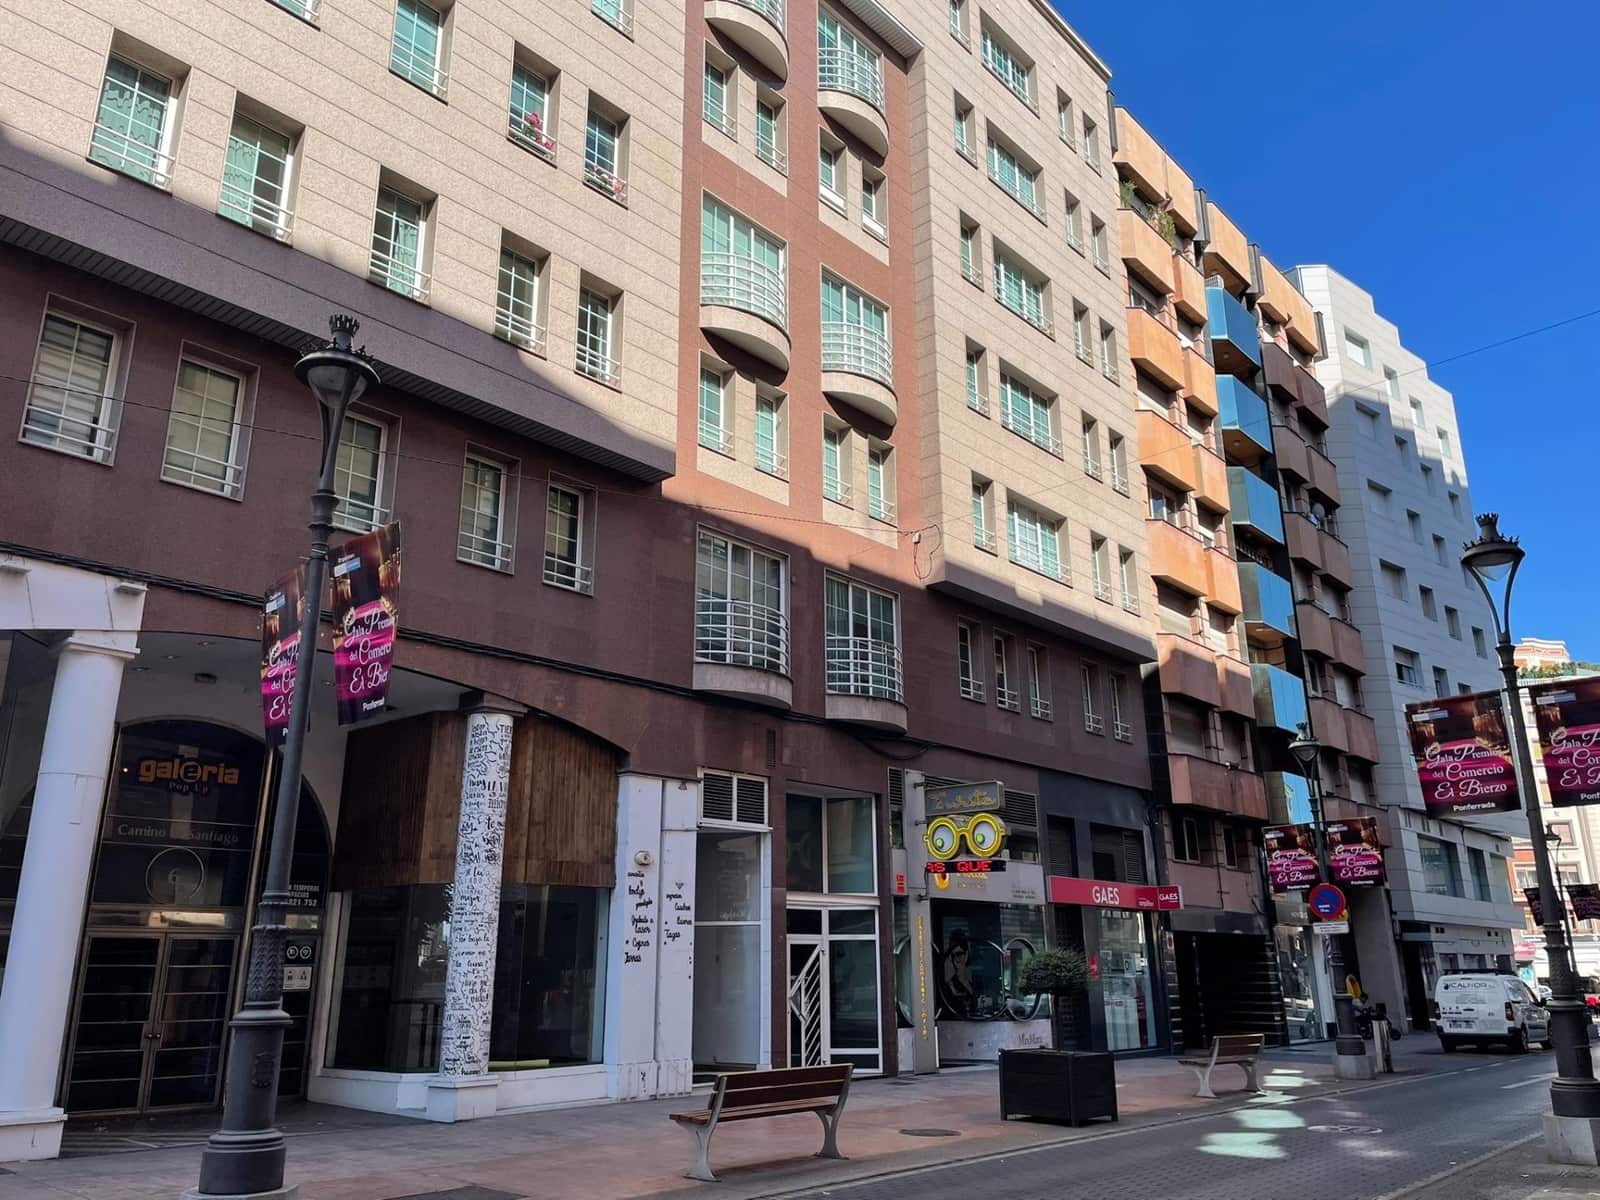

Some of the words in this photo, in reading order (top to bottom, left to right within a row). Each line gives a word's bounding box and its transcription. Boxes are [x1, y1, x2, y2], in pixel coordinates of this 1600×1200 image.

[1550, 729, 1581, 755] Gala
[1425, 744, 1454, 769] Gala
[1558, 757, 1570, 765] del
[138, 758, 240, 785] galeria
[1433, 769, 1444, 778] del
[1446, 763, 1504, 781] Comercio
[1560, 770, 1582, 787] El
[1434, 782, 1455, 800] El
[1459, 779, 1508, 797] Bierzo
[1453, 802, 1496, 812] Ponferrada
[118, 824, 167, 839] Camino
[956, 860, 993, 872] QUE
[1092, 885, 1120, 905] GAES
[1160, 892, 1178, 901] GAES
